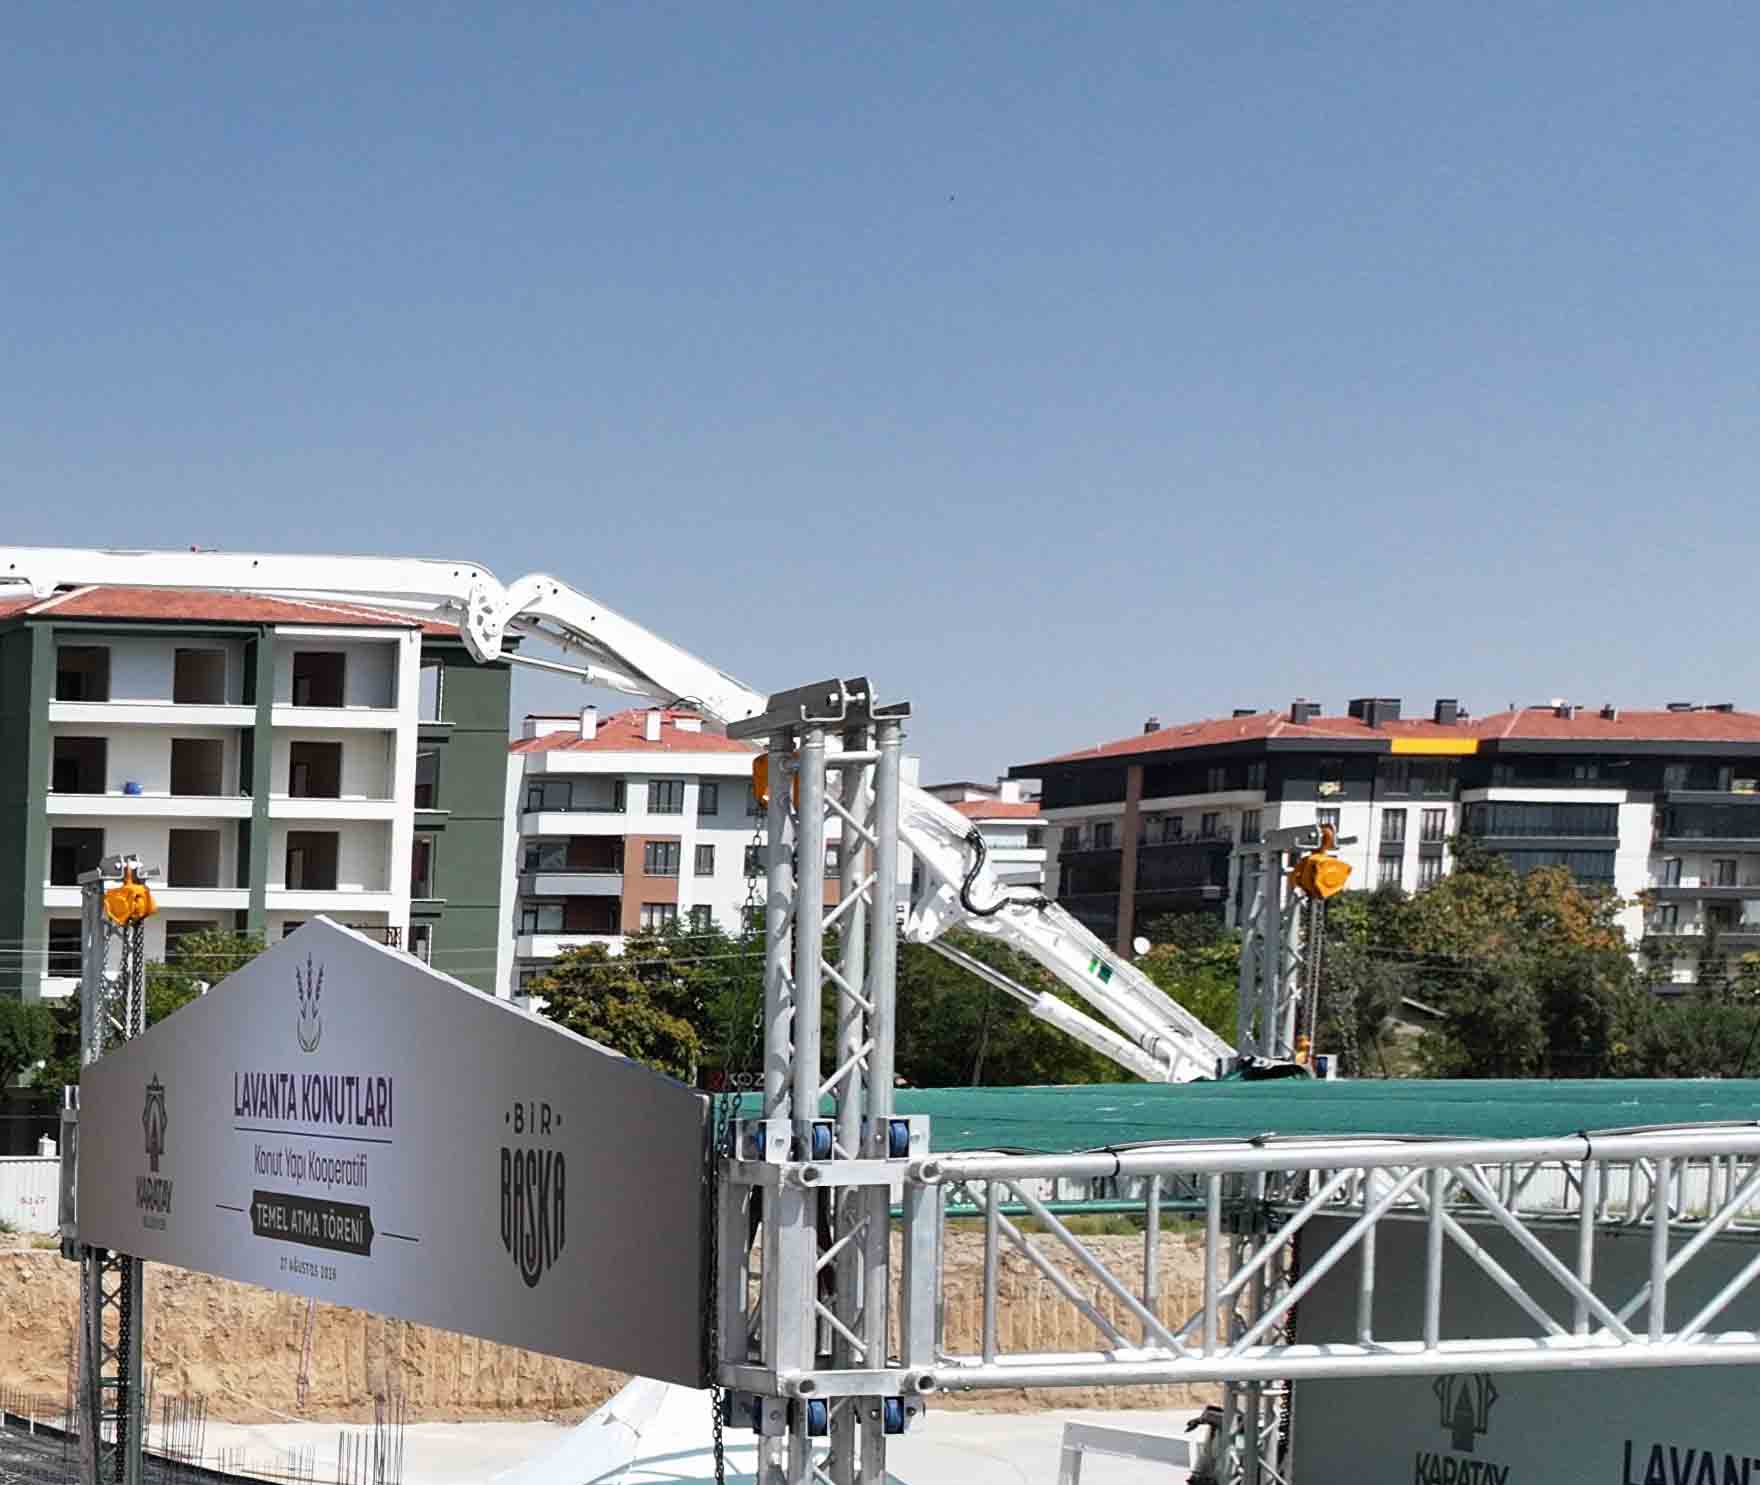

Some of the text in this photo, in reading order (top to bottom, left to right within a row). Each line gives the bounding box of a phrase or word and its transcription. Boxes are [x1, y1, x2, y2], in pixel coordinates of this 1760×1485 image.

[234, 1072, 392, 1128] LAVANTA KONUTLARI
[254, 1144, 368, 1190] Konut Yapı Kooperatifi
[256, 1203, 364, 1244] TEMEL ATMA TÖRENİ
